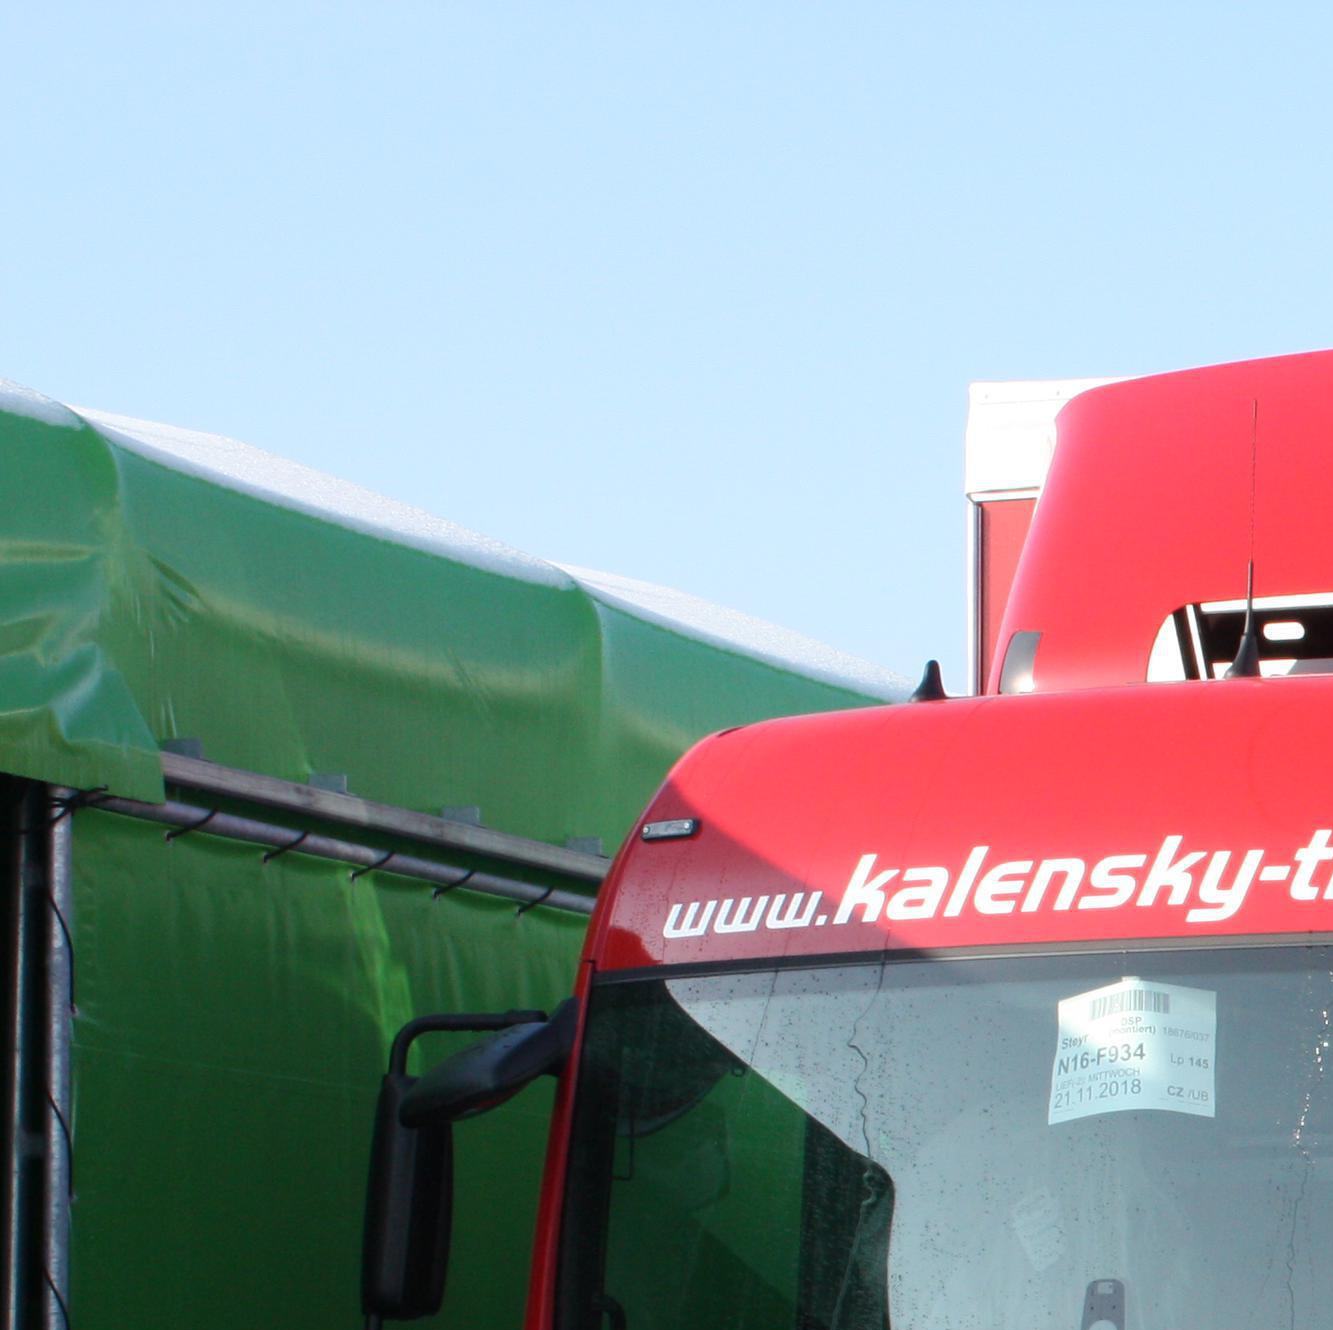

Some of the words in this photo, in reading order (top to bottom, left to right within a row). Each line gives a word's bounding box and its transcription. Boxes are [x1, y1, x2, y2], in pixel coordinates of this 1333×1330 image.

[1057, 1042, 1146, 1076] N16-F934
[1054, 1078, 1142, 1109] 21.11.2018
[1167, 1085, 1184, 1098] CZ
